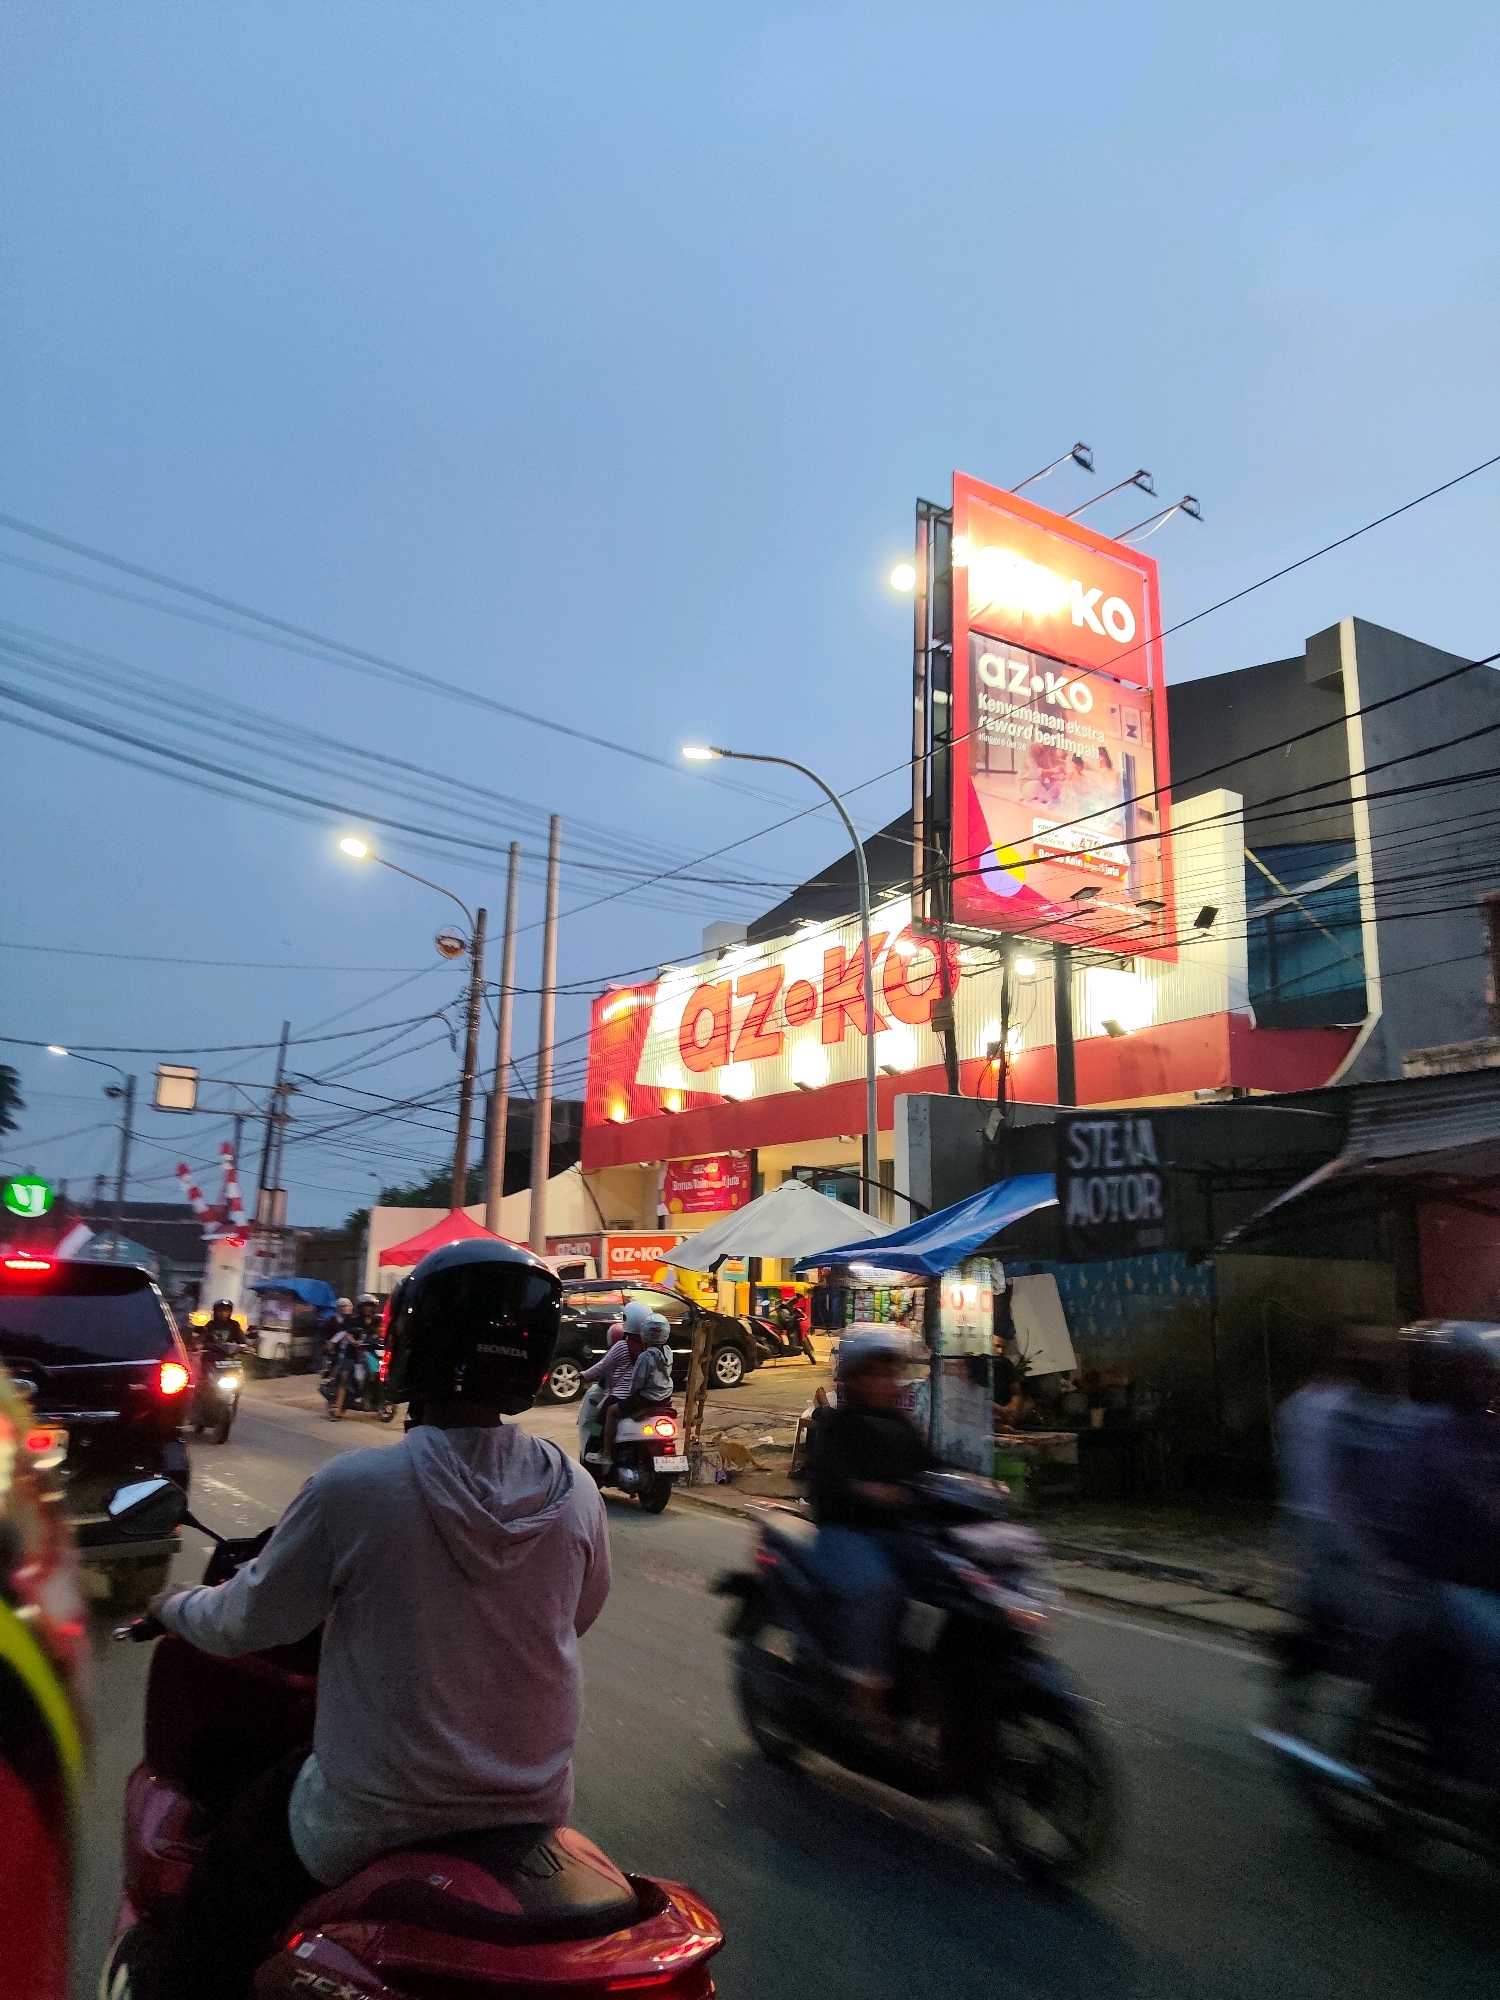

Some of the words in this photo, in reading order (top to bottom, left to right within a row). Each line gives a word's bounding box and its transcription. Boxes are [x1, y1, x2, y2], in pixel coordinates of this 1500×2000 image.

[977, 692, 1065, 732] Kenyamanan
[978, 714, 1034, 741] reward
[1034, 727, 1100, 760] berlimpah
[476, 1343, 528, 1359] HONDA
